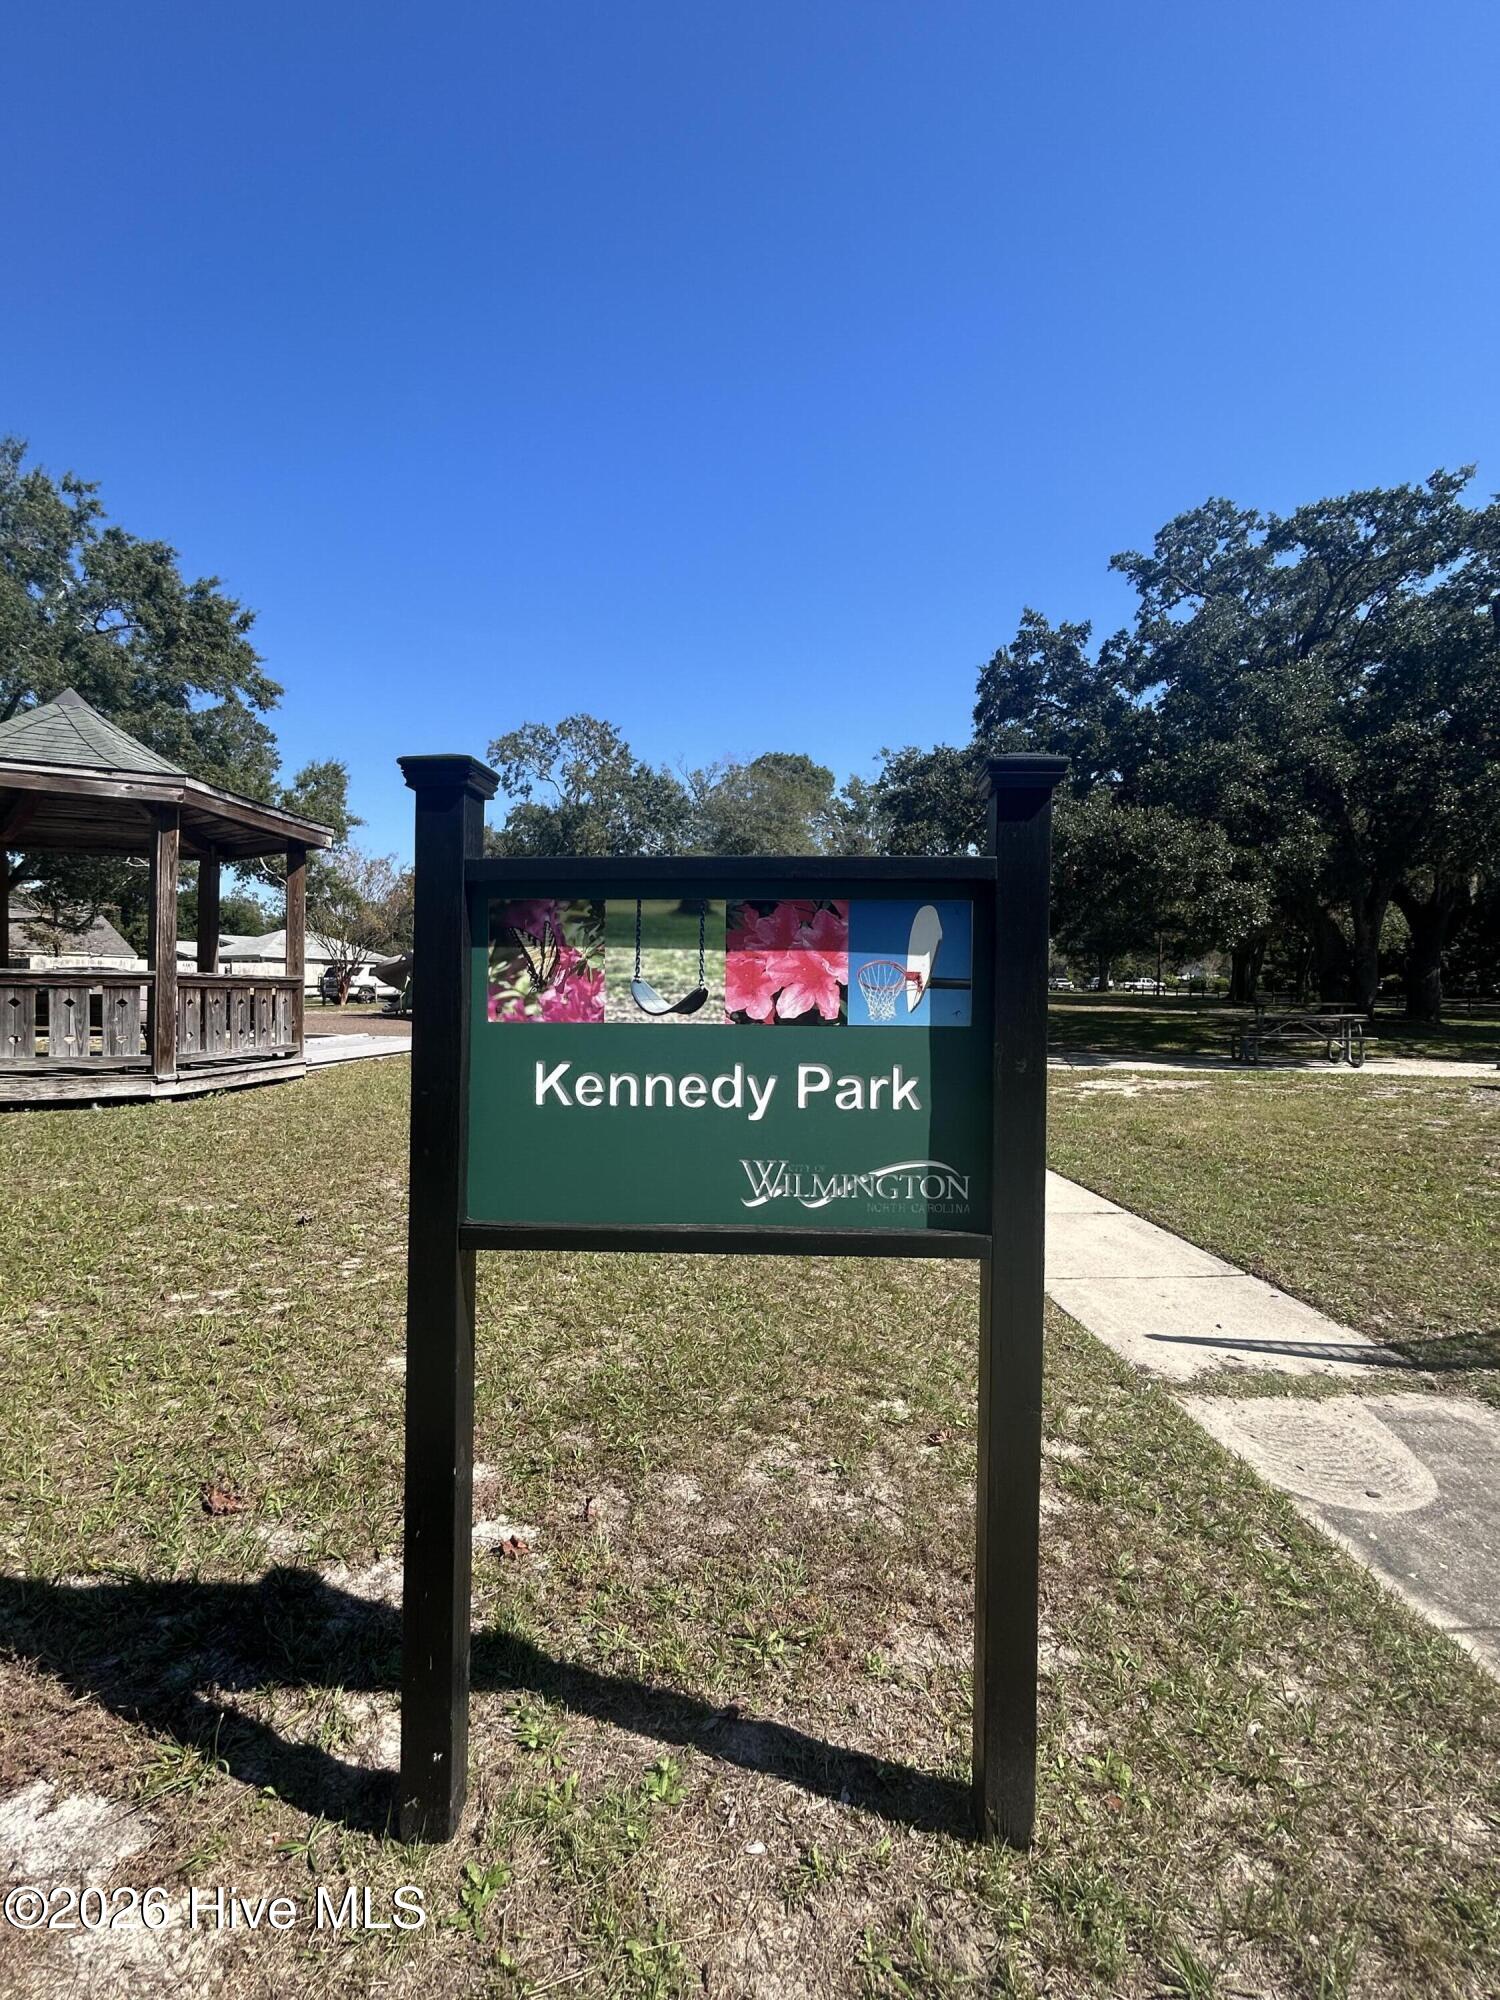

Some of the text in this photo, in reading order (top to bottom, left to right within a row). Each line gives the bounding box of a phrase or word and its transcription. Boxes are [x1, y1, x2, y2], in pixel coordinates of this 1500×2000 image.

[534, 1060, 922, 1121] Kennedy Park
[739, 1159, 971, 1201] WILMINGTON
[866, 1203, 971, 1214] NORTH CAROLINA
